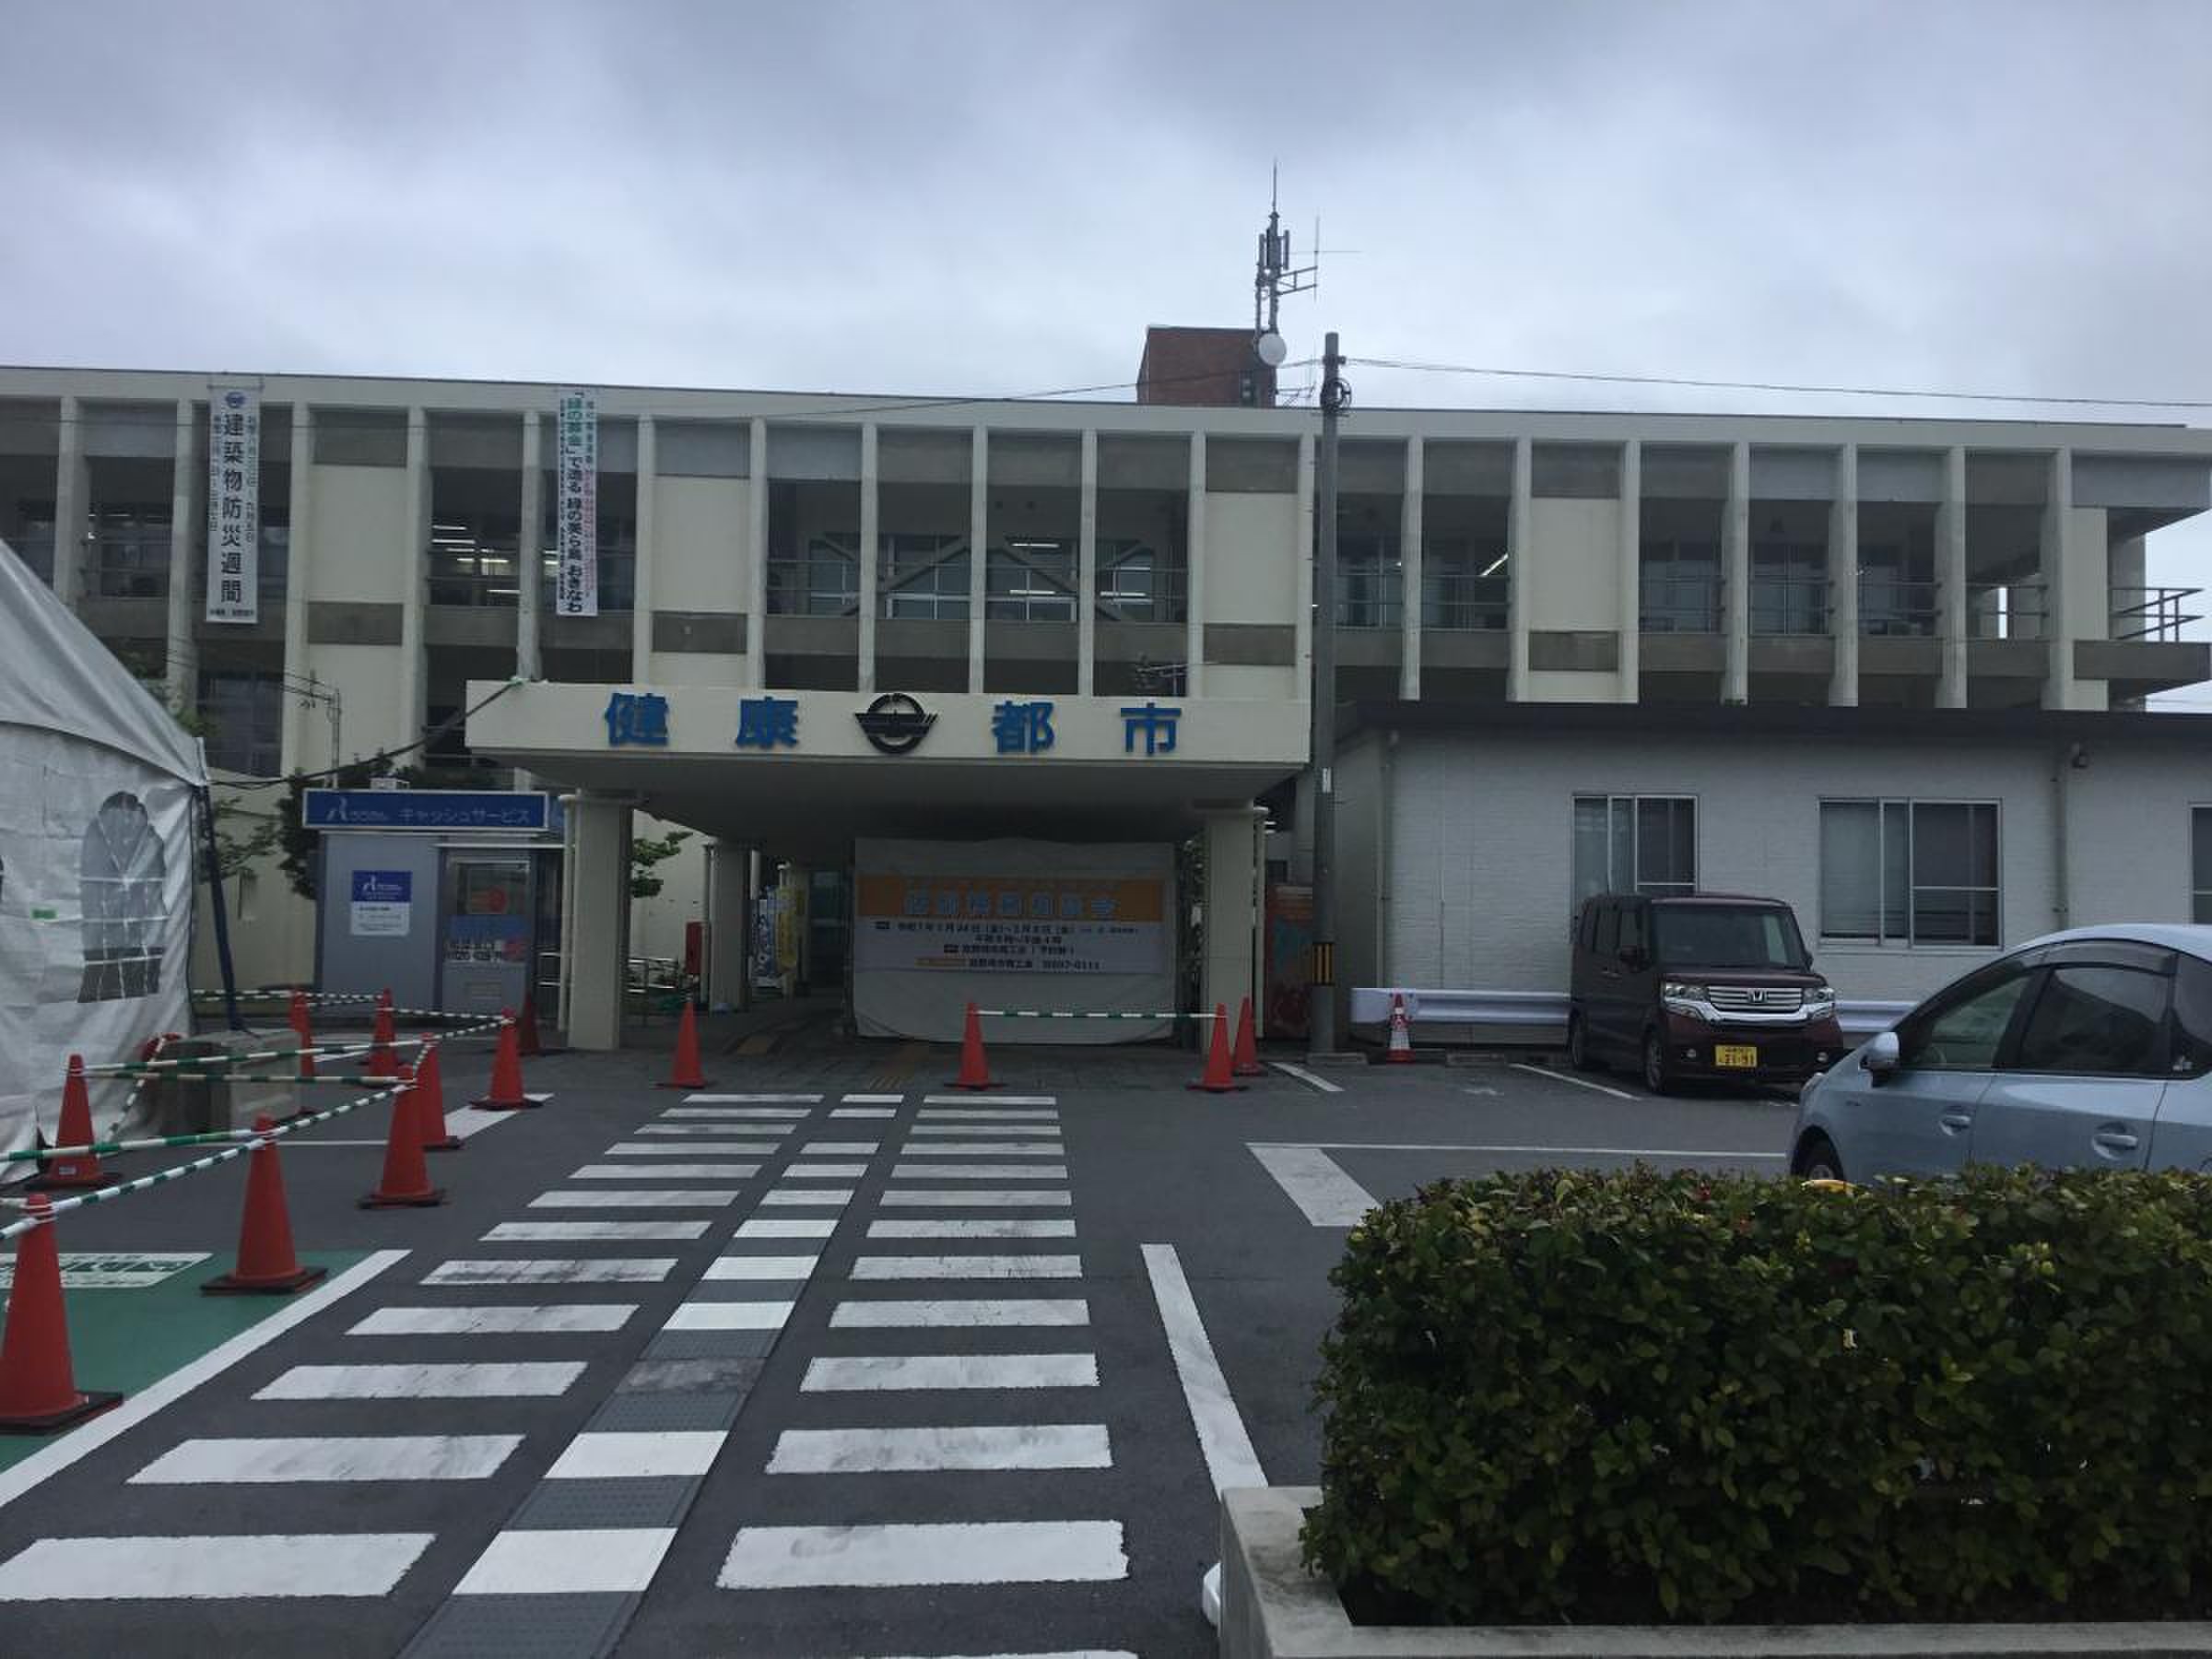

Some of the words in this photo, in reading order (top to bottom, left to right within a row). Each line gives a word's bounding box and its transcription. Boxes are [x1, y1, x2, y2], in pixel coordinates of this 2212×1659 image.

[221, 413, 244, 604] 建築物防災週間
